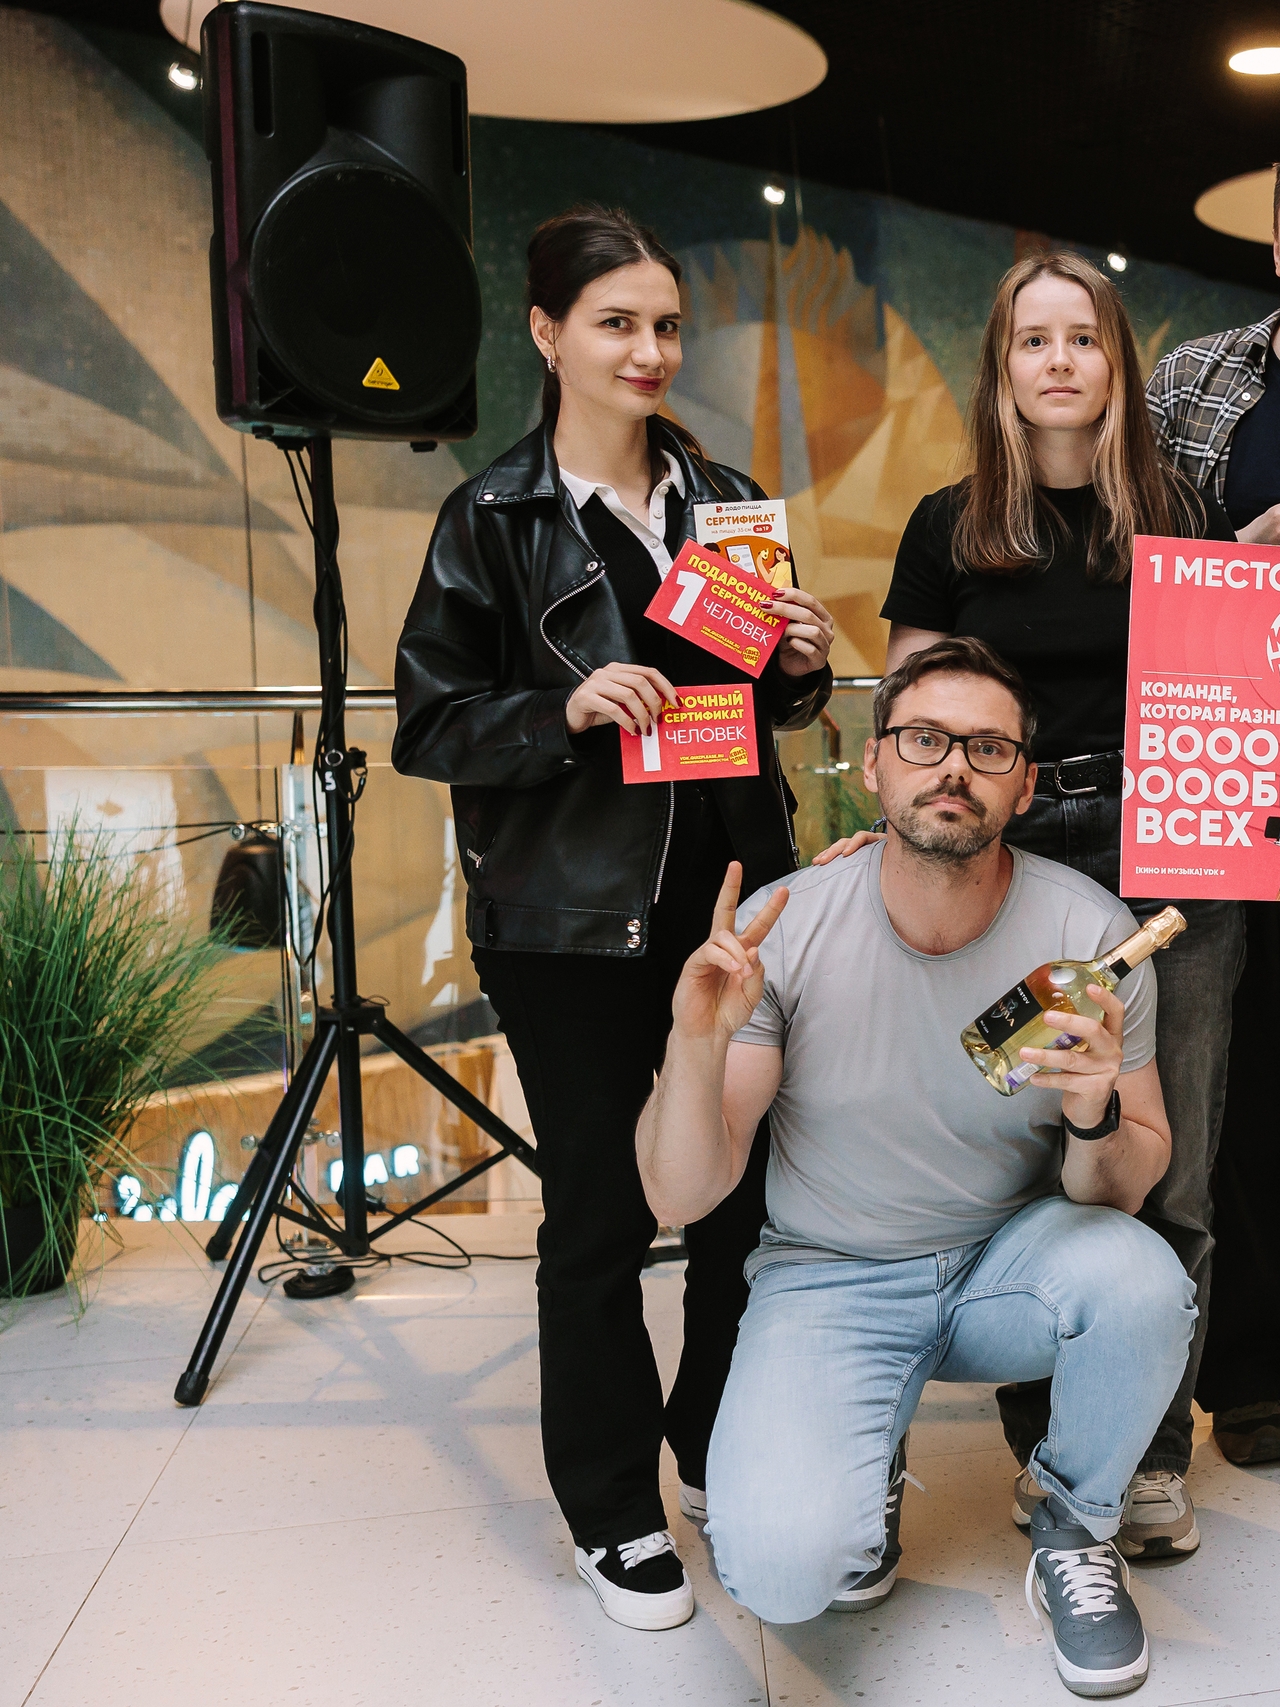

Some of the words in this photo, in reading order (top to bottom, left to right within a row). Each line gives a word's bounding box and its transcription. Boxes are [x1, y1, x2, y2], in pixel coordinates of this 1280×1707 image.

[705, 513, 776, 527] СЕРТИФИКАТ
[687, 554, 774, 604] ПОДАРОЧН
[1149, 554, 1163, 583] 1
[668, 570, 707, 627] 1
[710, 584, 780, 628] СЕРТИФИКАТ
[702, 597, 773, 647] ЧЕЛОВЕК
[1141, 681, 1238, 703] КОМАНДЕ,
[664, 709, 744, 724] СЕРТИФИКАТ
[1140, 703, 1226, 723] КОТОРАЯ
[665, 725, 747, 745] ЧЕЛОВЕК
[1136, 807, 1254, 847] ВСЕХ
[1135, 865, 1160, 875] [КИНО
[1160, 867, 1166, 875] И
[1167, 867, 1203, 876] МУЗЫКА]
